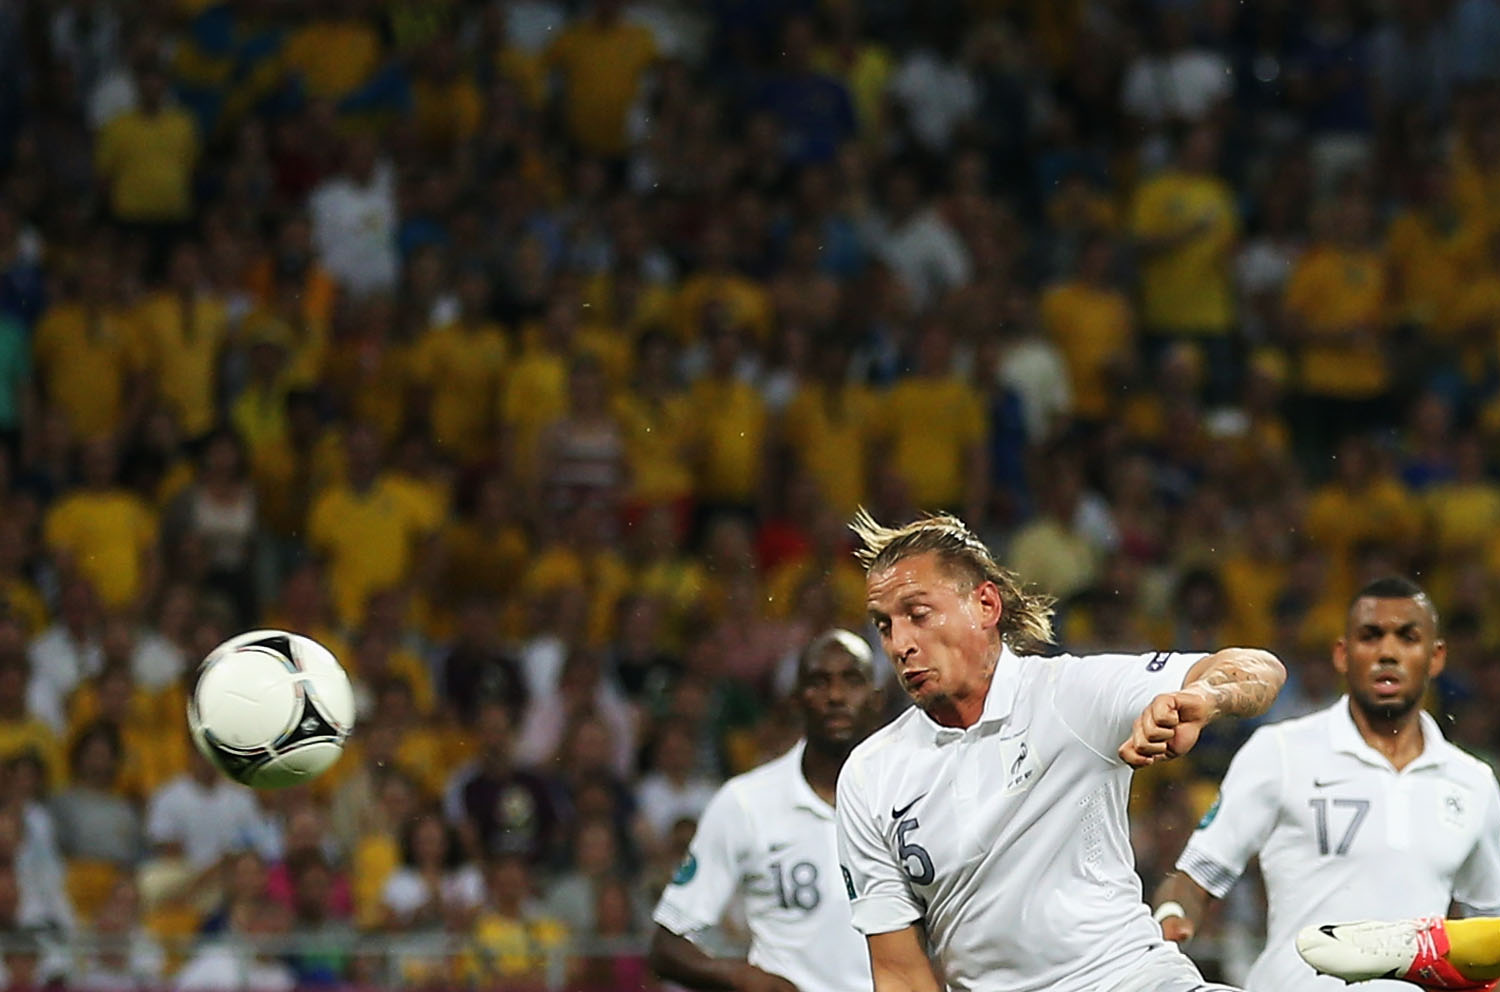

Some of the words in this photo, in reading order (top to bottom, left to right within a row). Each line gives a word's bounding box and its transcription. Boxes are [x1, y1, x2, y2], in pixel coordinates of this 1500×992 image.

[897, 818, 935, 886] 5
[1309, 798, 1371, 856] 17
[769, 861, 820, 911] 18
